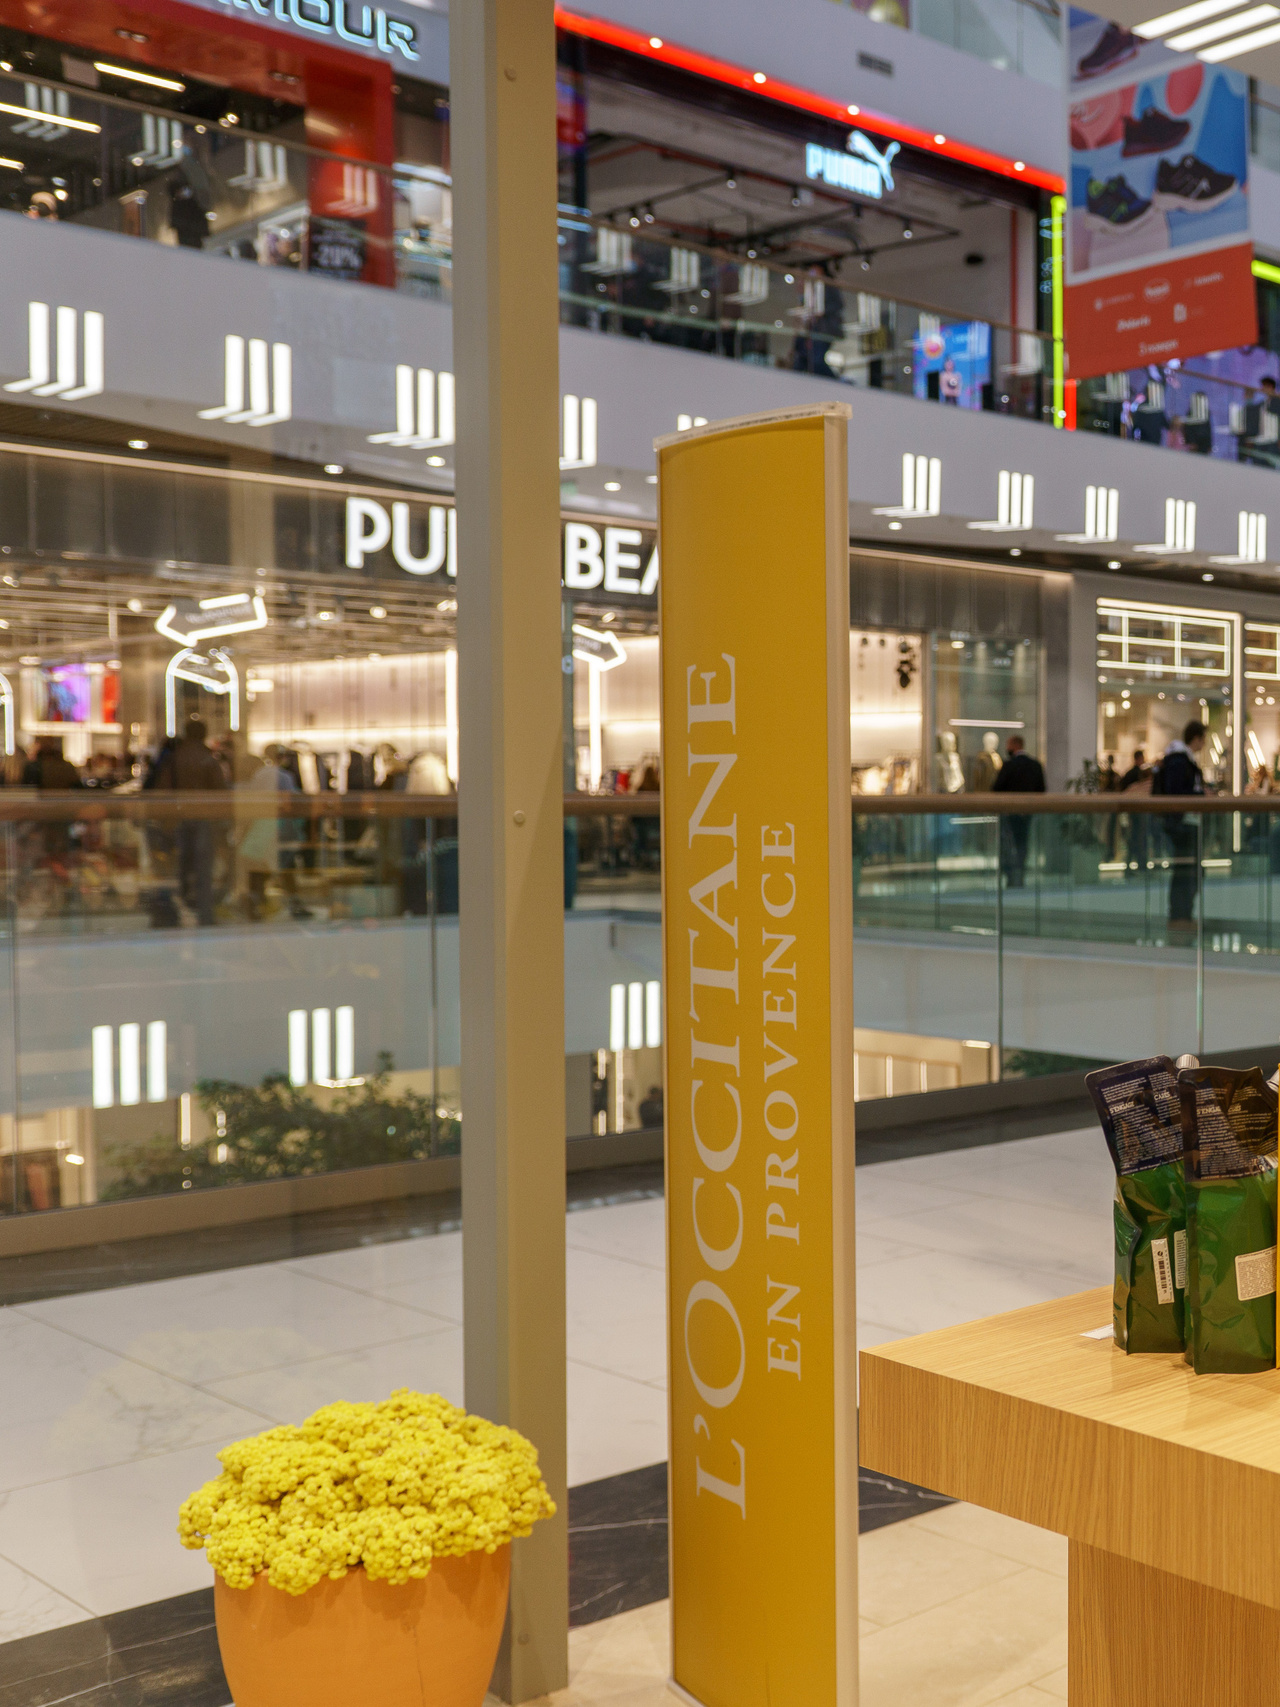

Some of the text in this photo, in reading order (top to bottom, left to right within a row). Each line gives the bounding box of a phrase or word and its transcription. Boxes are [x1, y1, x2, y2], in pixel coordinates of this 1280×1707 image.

[806, 143, 882, 199] PUMA
[346, 496, 457, 576] PU
[684, 652, 746, 1520] L'OCCITANE
[761, 821, 800, 1381] EN PROVENCE
